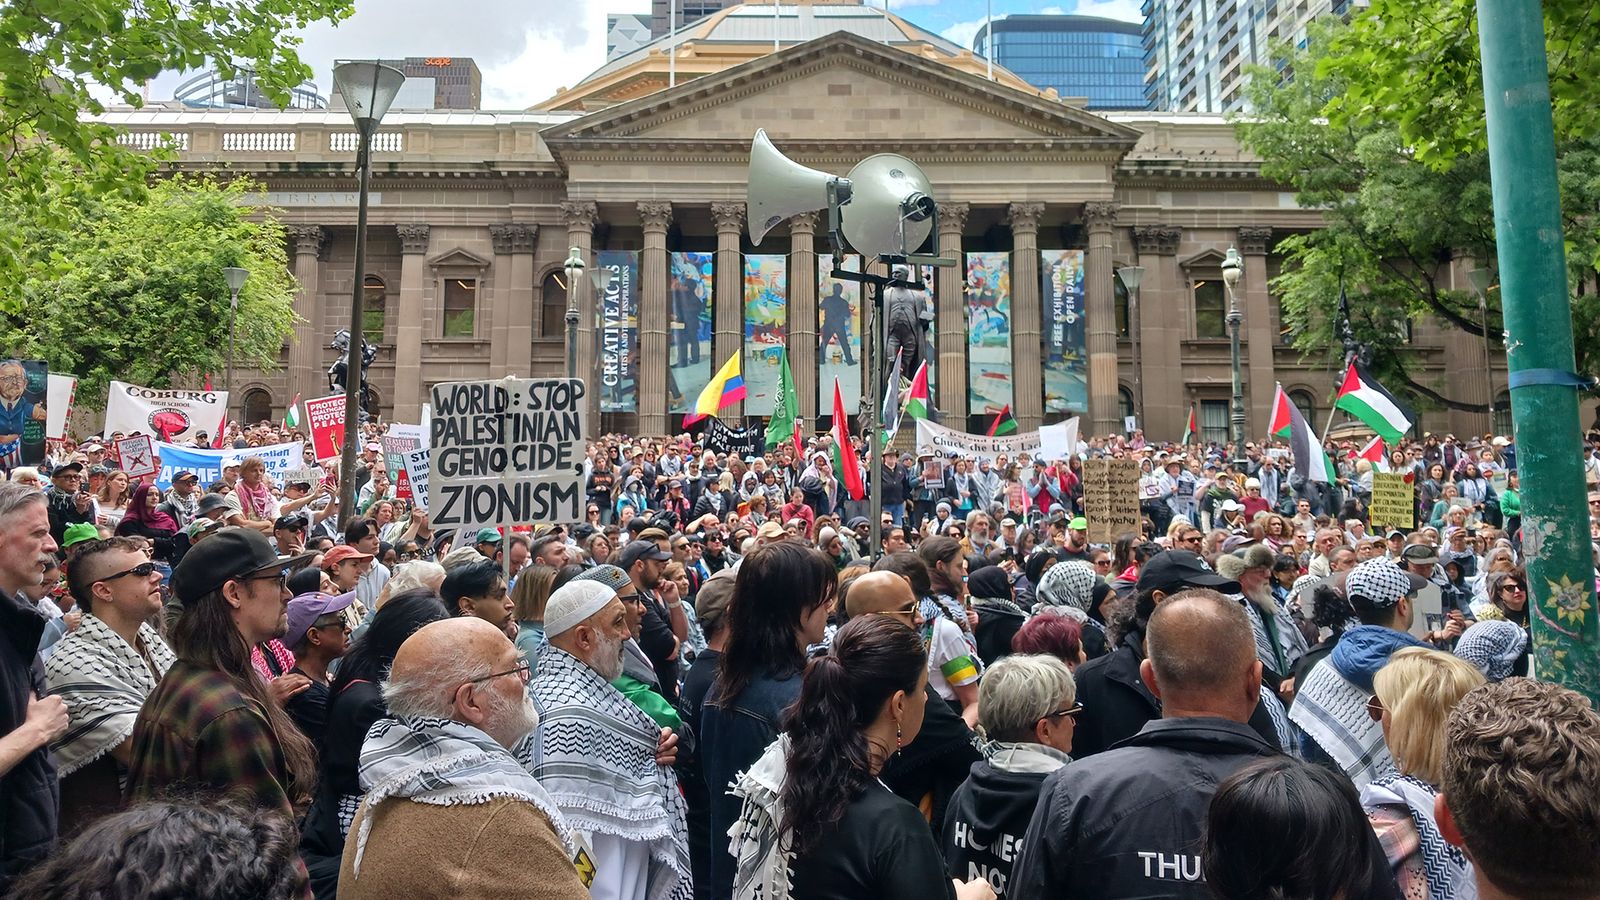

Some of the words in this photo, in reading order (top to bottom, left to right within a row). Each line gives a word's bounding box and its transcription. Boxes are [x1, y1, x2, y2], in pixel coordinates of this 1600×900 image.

[424, 58, 451, 68] scape
[1066, 265, 1075, 294] DAILY
[1053, 265, 1063, 321] EXHIBITION
[1066, 296, 1075, 324] OPEN
[621, 334, 629, 349] AND
[1054, 324, 1063, 347] FREE
[604, 307, 619, 387] CREATIVE
[126, 386, 217, 404] COBURG
[527, 379, 585, 411] STOP
[312, 411, 345, 423] PROTEC
[313, 418, 345, 429] PEAC
[431, 411, 581, 448] PALESTINIAN
[713, 430, 728, 443] FOR
[385, 438, 414, 448] CEASEFIRE
[711, 437, 756, 452] PALESTINE
[933, 436, 965, 450] Chuck
[970, 443, 987, 453] the
[992, 442, 1016, 452] U.S.
[279, 459, 288, 468] &
[411, 450, 430, 463] STO
[437, 442, 583, 477] GENOCIDE,
[934, 450, 948, 460] Ou
[432, 481, 579, 524] ZIONISM
[1138, 851, 1206, 881] THU
